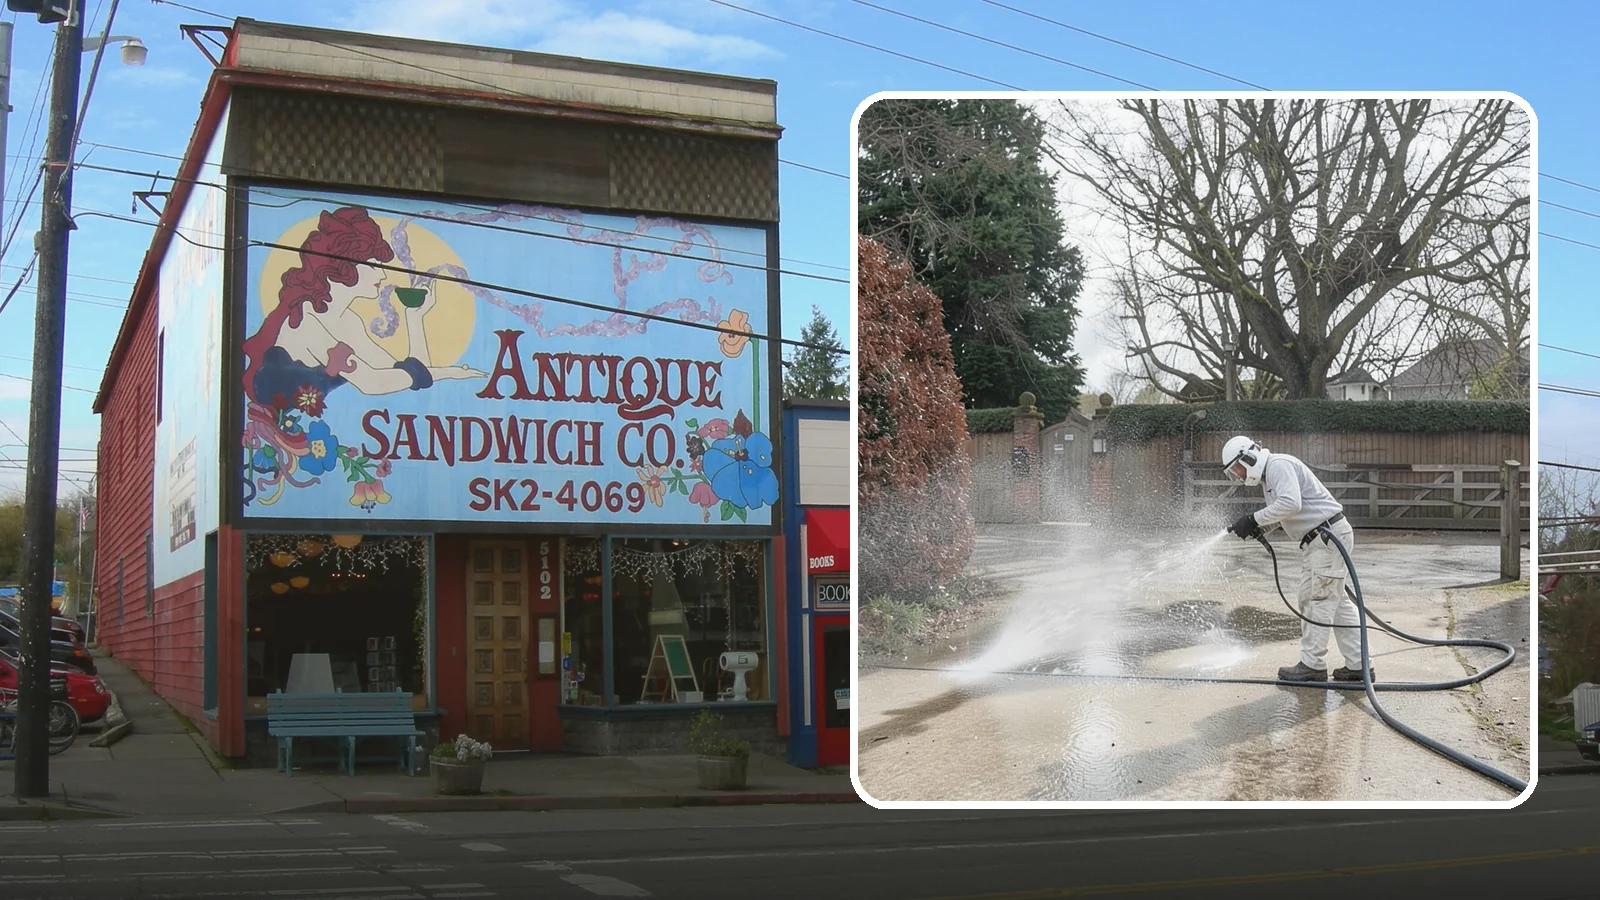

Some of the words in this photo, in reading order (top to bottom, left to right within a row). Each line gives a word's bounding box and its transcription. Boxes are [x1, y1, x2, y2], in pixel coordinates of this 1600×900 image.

[476, 329, 723, 420] ANTIQUE
[361, 408, 604, 467] SANDWICH
[617, 422, 684, 468] CO.
[468, 477, 645, 513] SK2-4069
[539, 541, 552, 600] 5102
[809, 555, 835, 569] BOOKS
